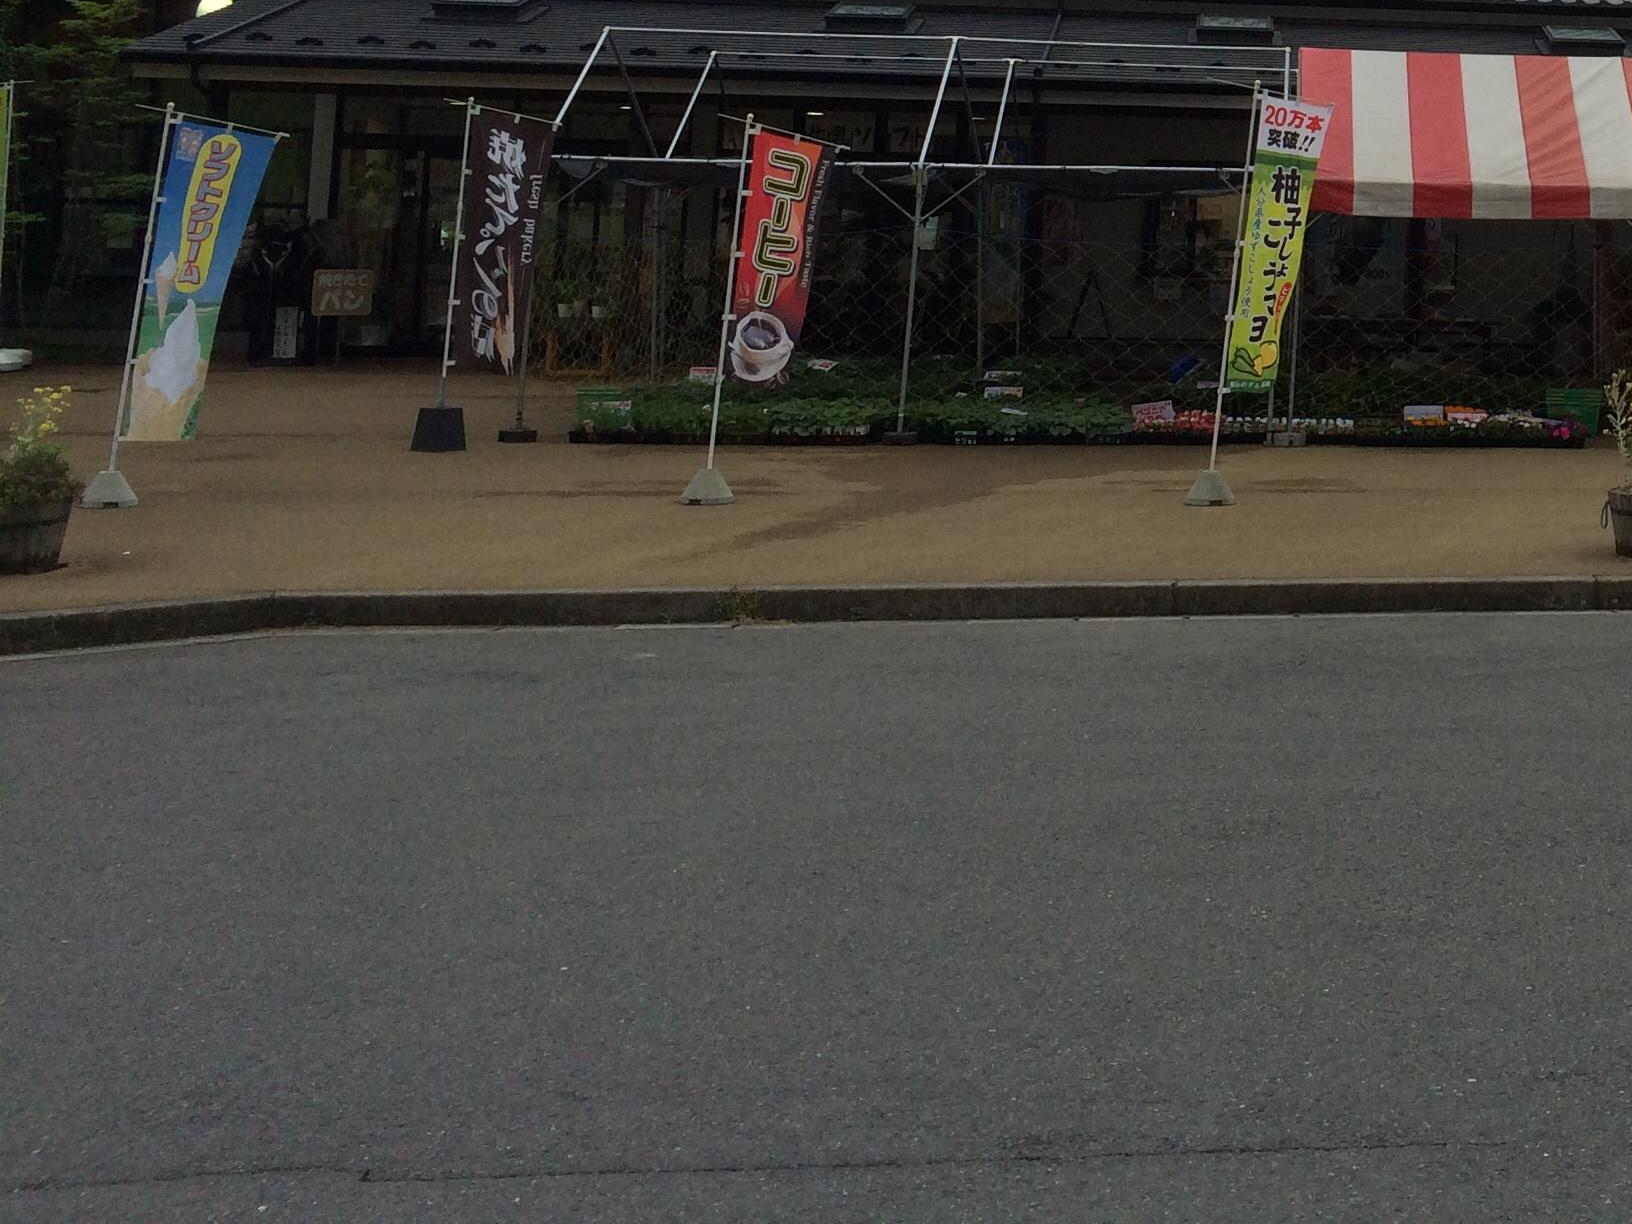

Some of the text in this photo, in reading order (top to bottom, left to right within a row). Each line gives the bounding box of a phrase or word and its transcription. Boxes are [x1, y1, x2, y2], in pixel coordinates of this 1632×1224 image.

[1264, 104, 1325, 133] 20万本
[1266, 128, 1317, 153] 突破!!
[818, 159, 831, 187] Fresh
[177, 140, 237, 287] ソフトクリーム
[752, 147, 812, 308] コーヒー
[319, 289, 365, 312] パン
